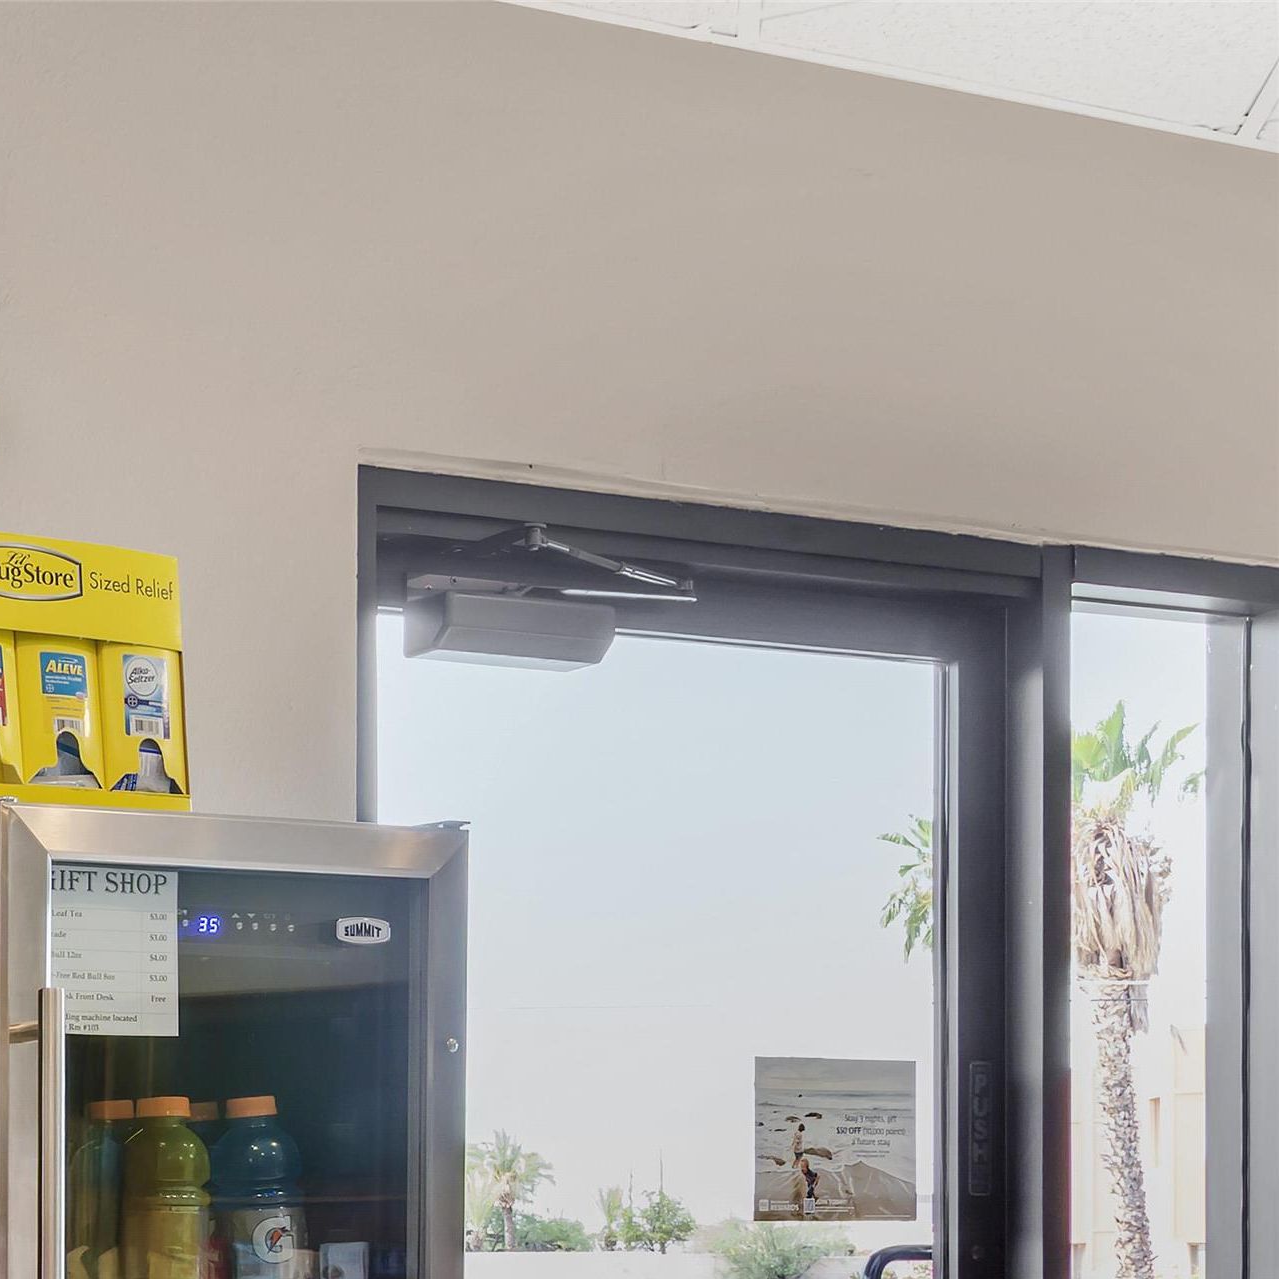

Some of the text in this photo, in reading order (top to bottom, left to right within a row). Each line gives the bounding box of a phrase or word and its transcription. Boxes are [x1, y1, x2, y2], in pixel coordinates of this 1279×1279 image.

[89, 572, 173, 600] Sized Relief
[46, 659, 83, 675] ALEVE
[128, 675, 155, 685] Seltzer
[104, 871, 167, 894] SHOP
[70, 910, 83, 918] Tea
[199, 917, 219, 933] 35
[344, 922, 382, 937] SUMMIT
[96, 993, 115, 1001] Desk
[150, 995, 167, 1003] Free
[112, 1014, 138, 1022] located
[848, 1126, 862, 1135] OFF
